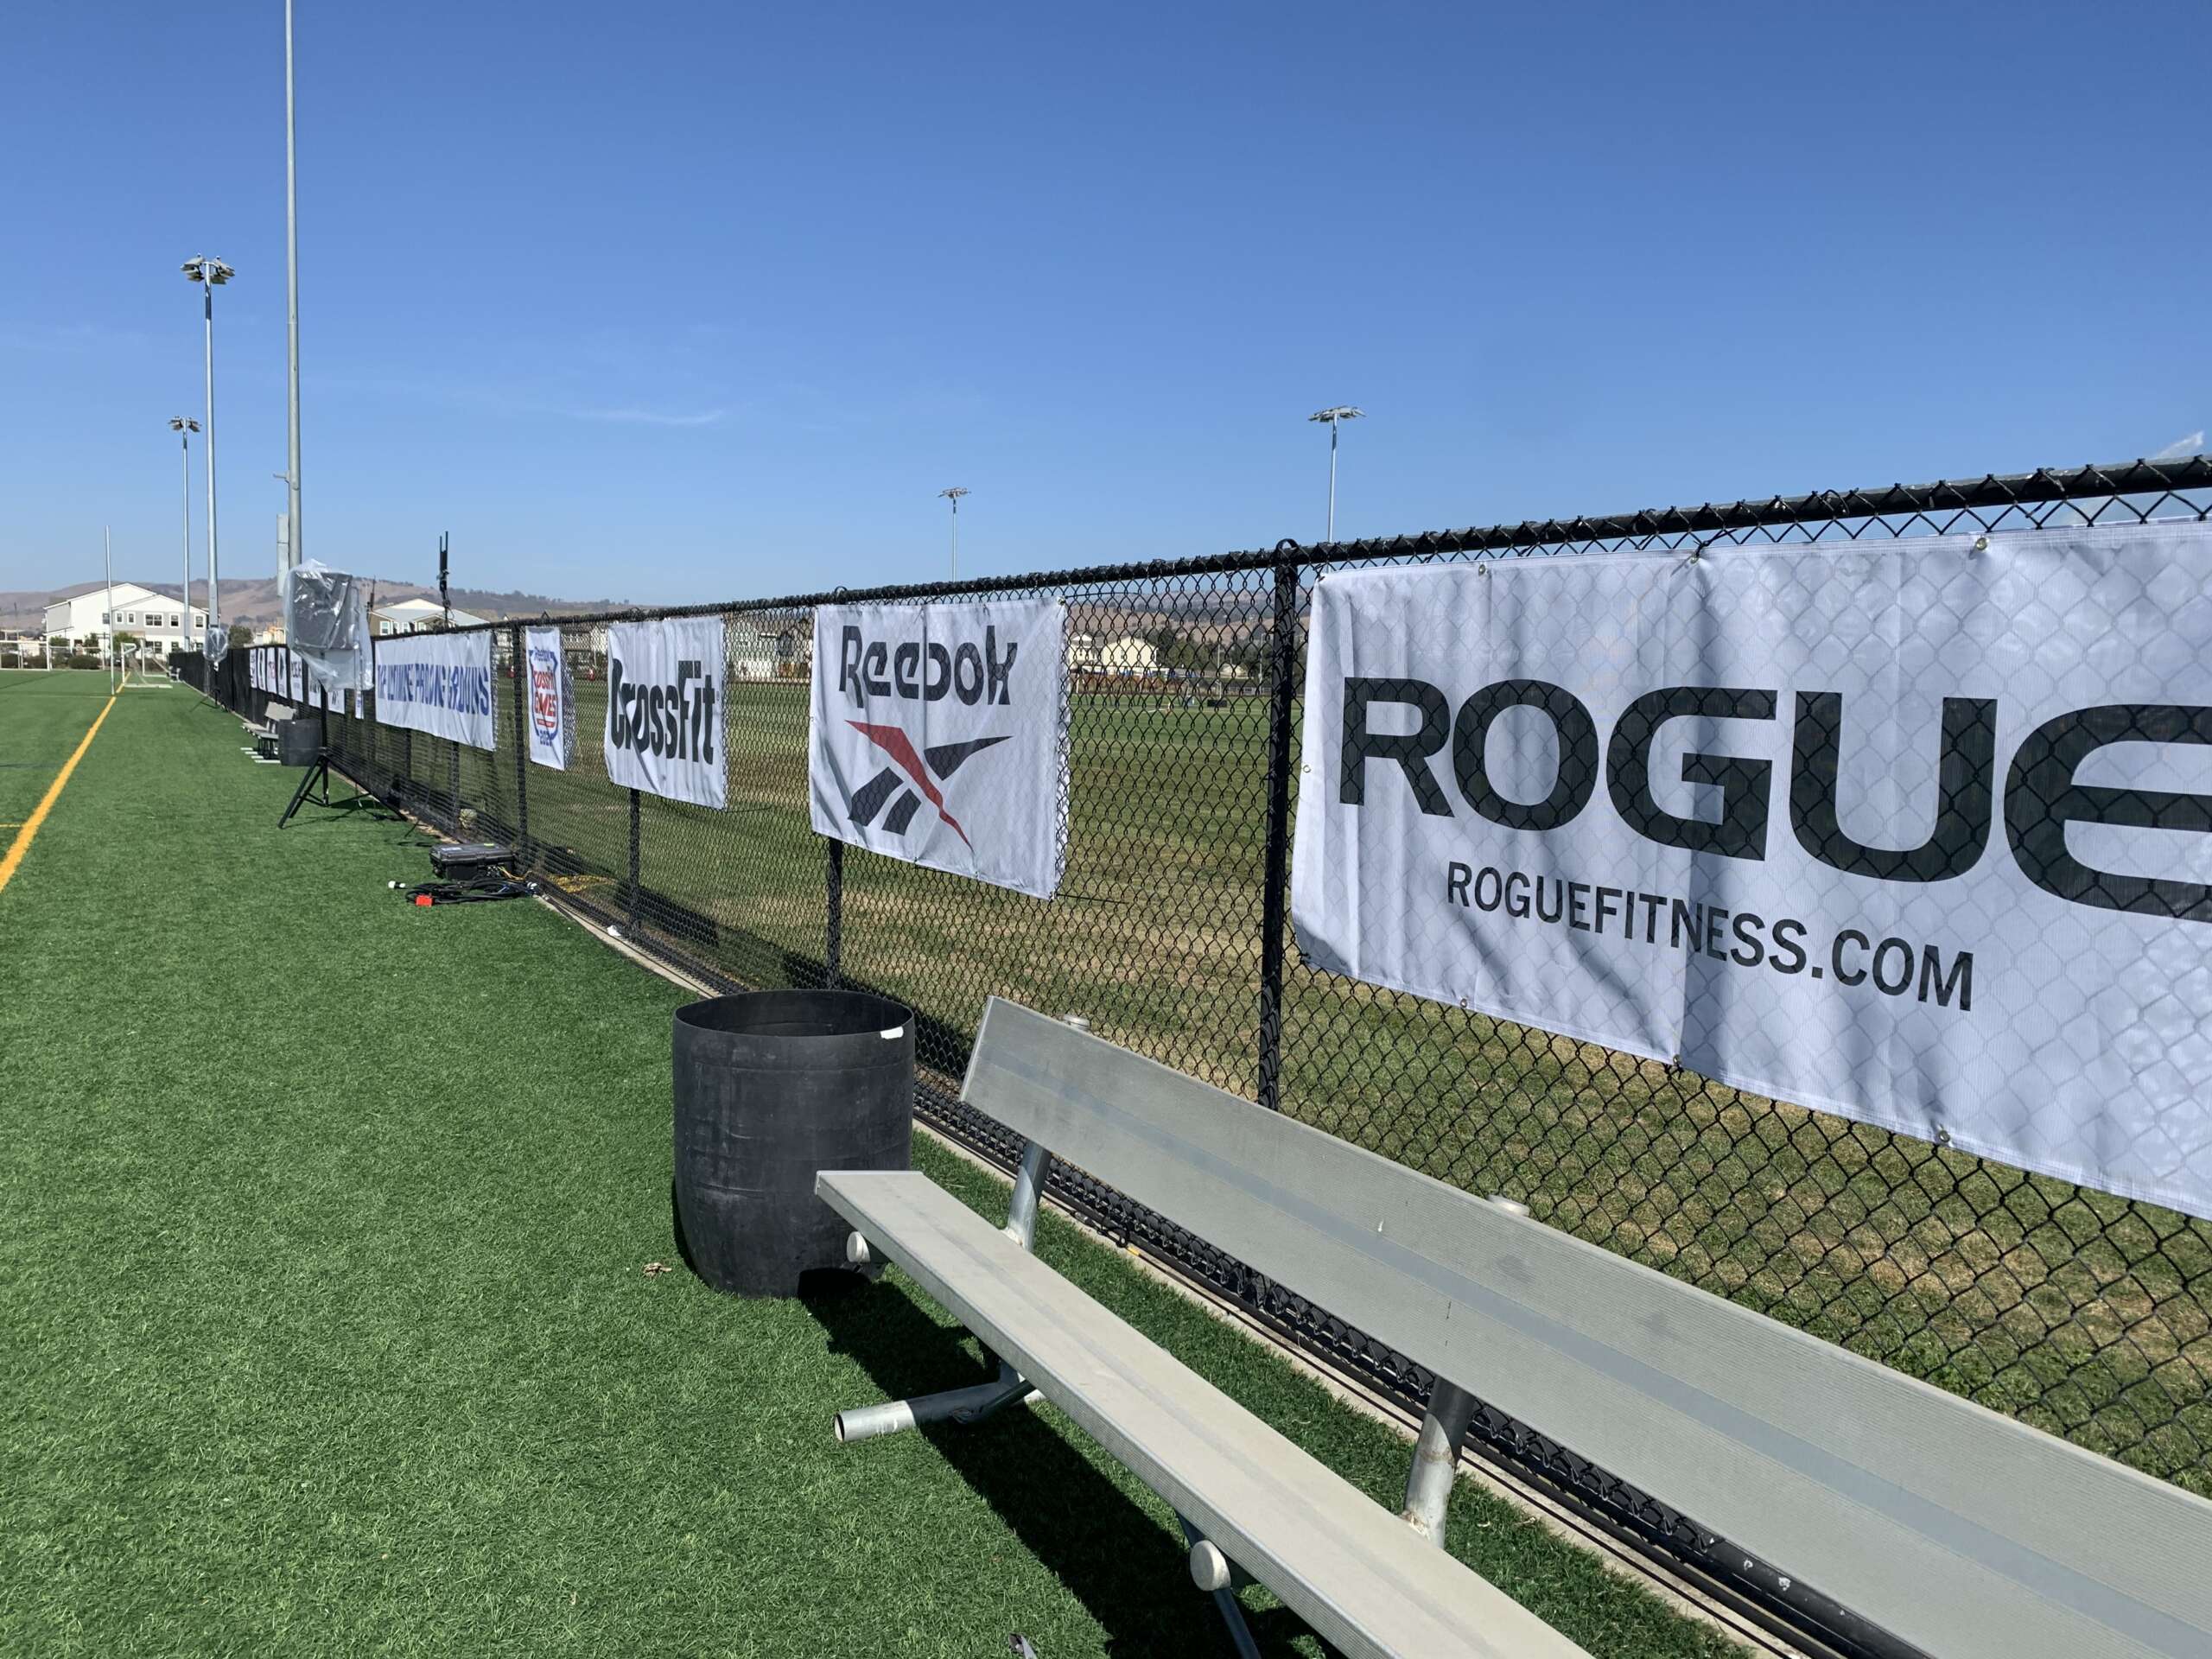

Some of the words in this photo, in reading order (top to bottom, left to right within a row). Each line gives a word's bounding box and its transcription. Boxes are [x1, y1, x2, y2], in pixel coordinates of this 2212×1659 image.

[611, 658, 715, 765] CrossFit
[839, 626, 1018, 708] Reebok
[1339, 677, 2212, 923] ROGUE
[1447, 861, 1974, 1012] ROGUEFITNESS.COM
